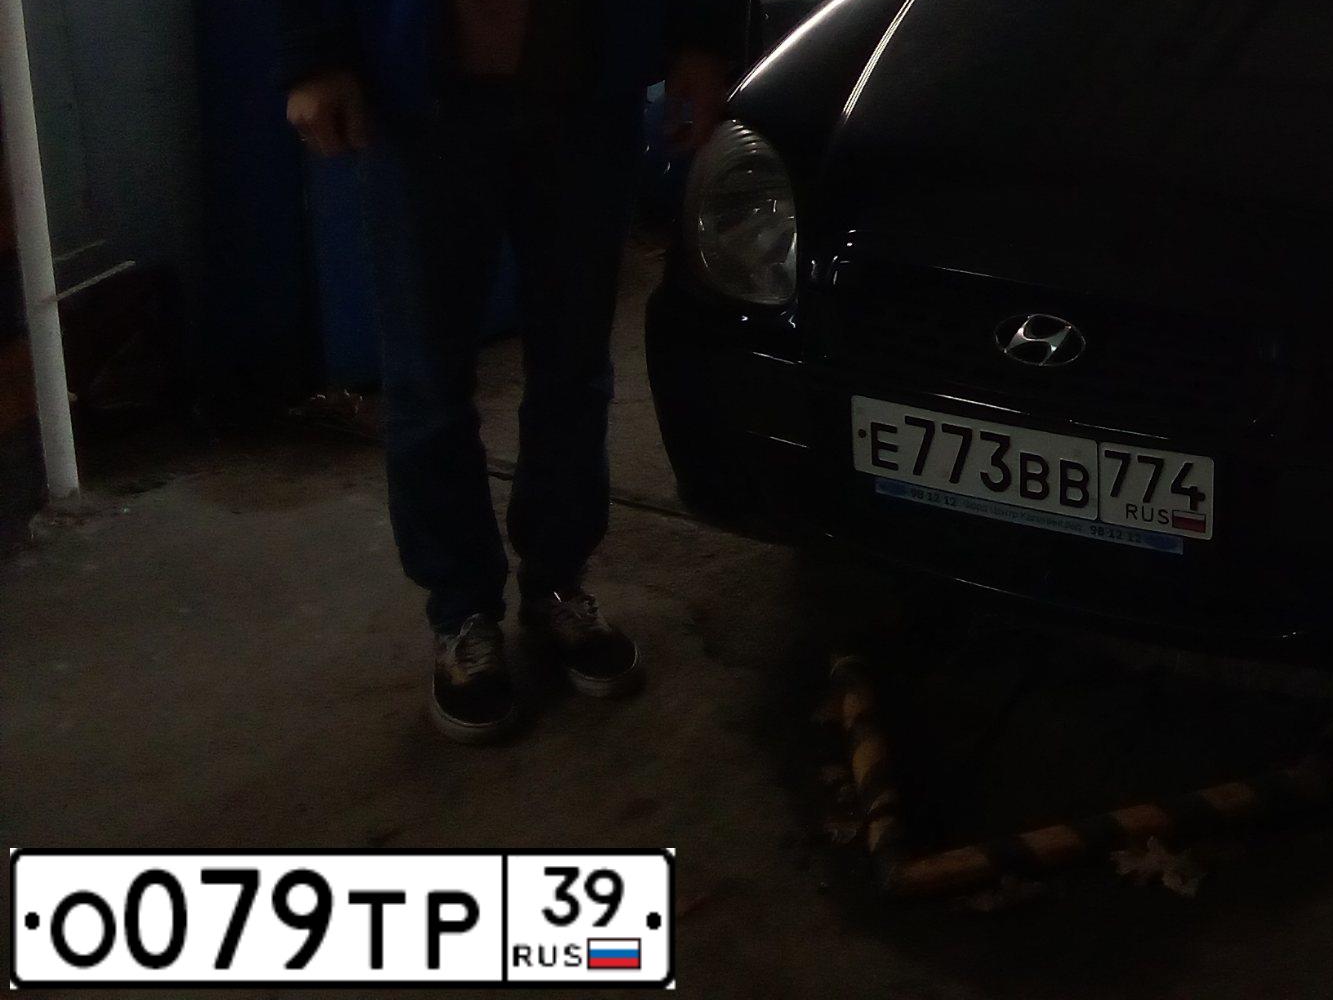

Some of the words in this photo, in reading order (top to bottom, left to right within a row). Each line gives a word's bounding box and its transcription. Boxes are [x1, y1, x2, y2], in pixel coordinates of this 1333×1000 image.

[869, 415, 1091, 509] Е773ВВ
[1104, 449, 1206, 511] 774
[1125, 503, 1170, 525] RUS
